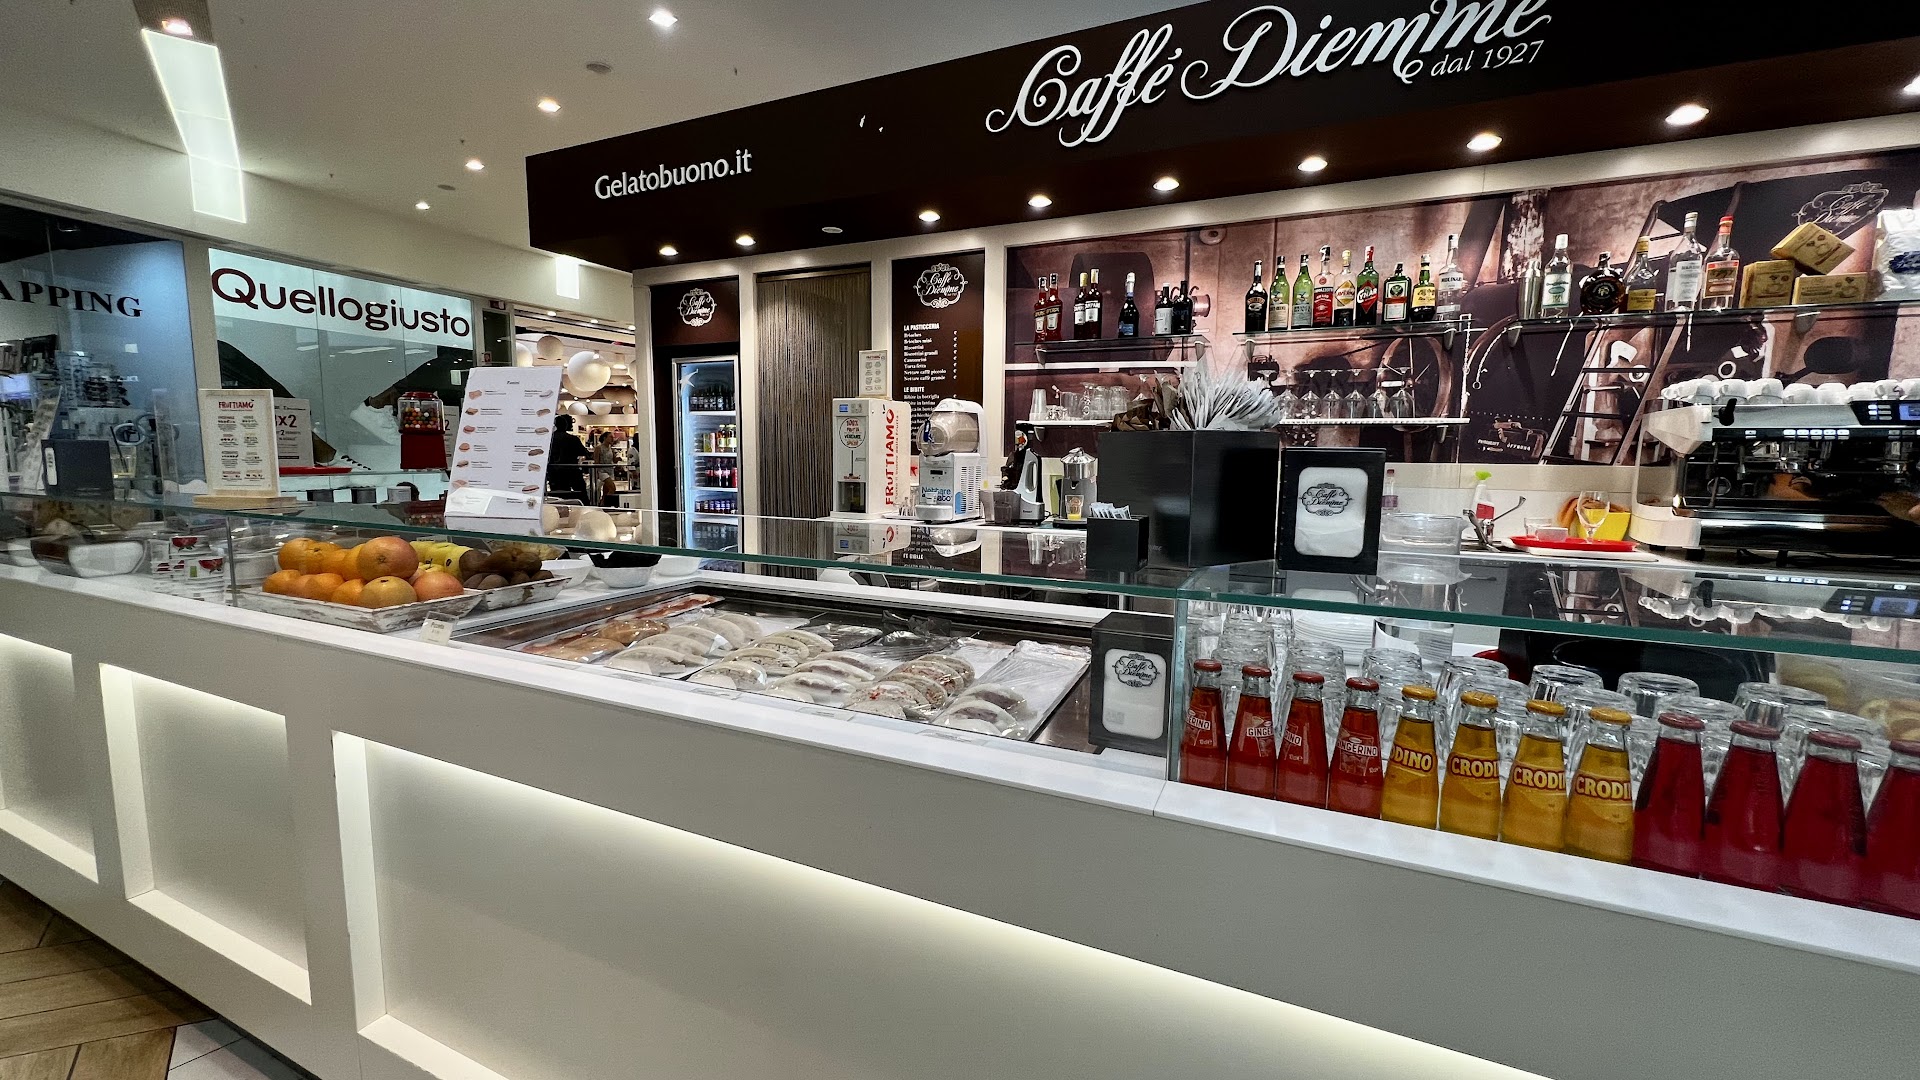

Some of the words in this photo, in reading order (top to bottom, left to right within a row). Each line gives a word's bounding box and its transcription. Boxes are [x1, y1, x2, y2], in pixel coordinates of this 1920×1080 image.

[1181, 0, 1552, 99] Diemme
[1431, 50, 1475, 77] dal
[1481, 39, 1545, 70] 1927
[594, 148, 753, 200] Gelatobuono.it
[211, 267, 471, 338] Quellogiusto
